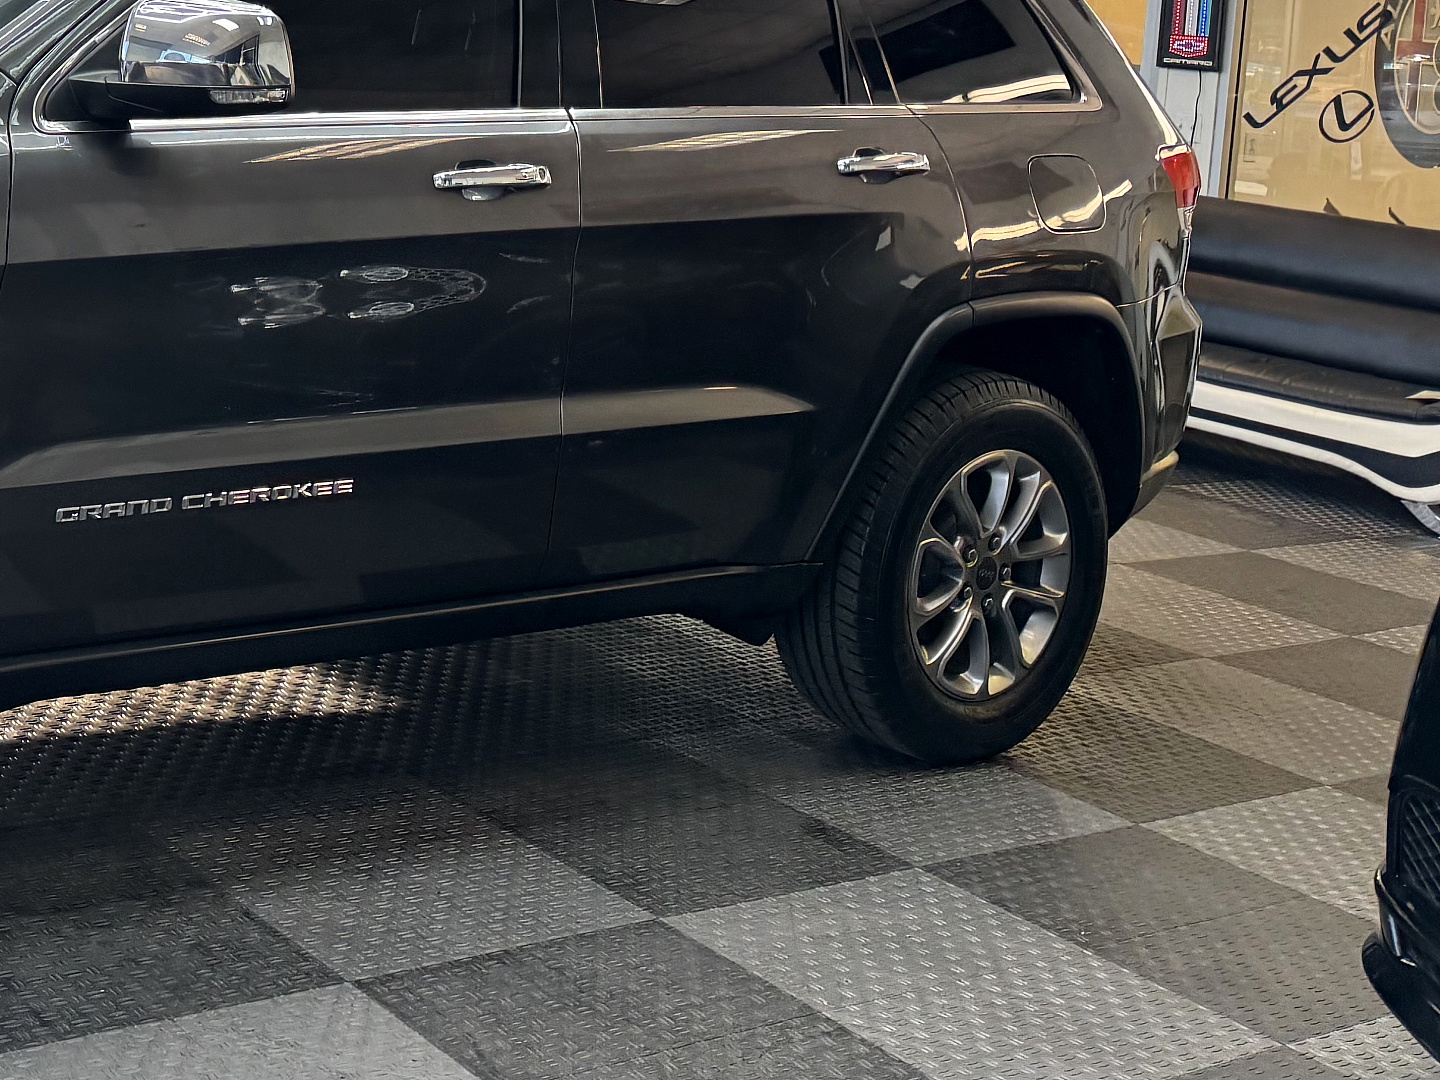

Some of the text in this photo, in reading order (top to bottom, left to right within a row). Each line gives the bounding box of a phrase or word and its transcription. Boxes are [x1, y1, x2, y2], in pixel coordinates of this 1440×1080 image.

[1242, 2, 1393, 130] LEXUS
[56, 478, 354, 522] GRAND CHEROKEE
